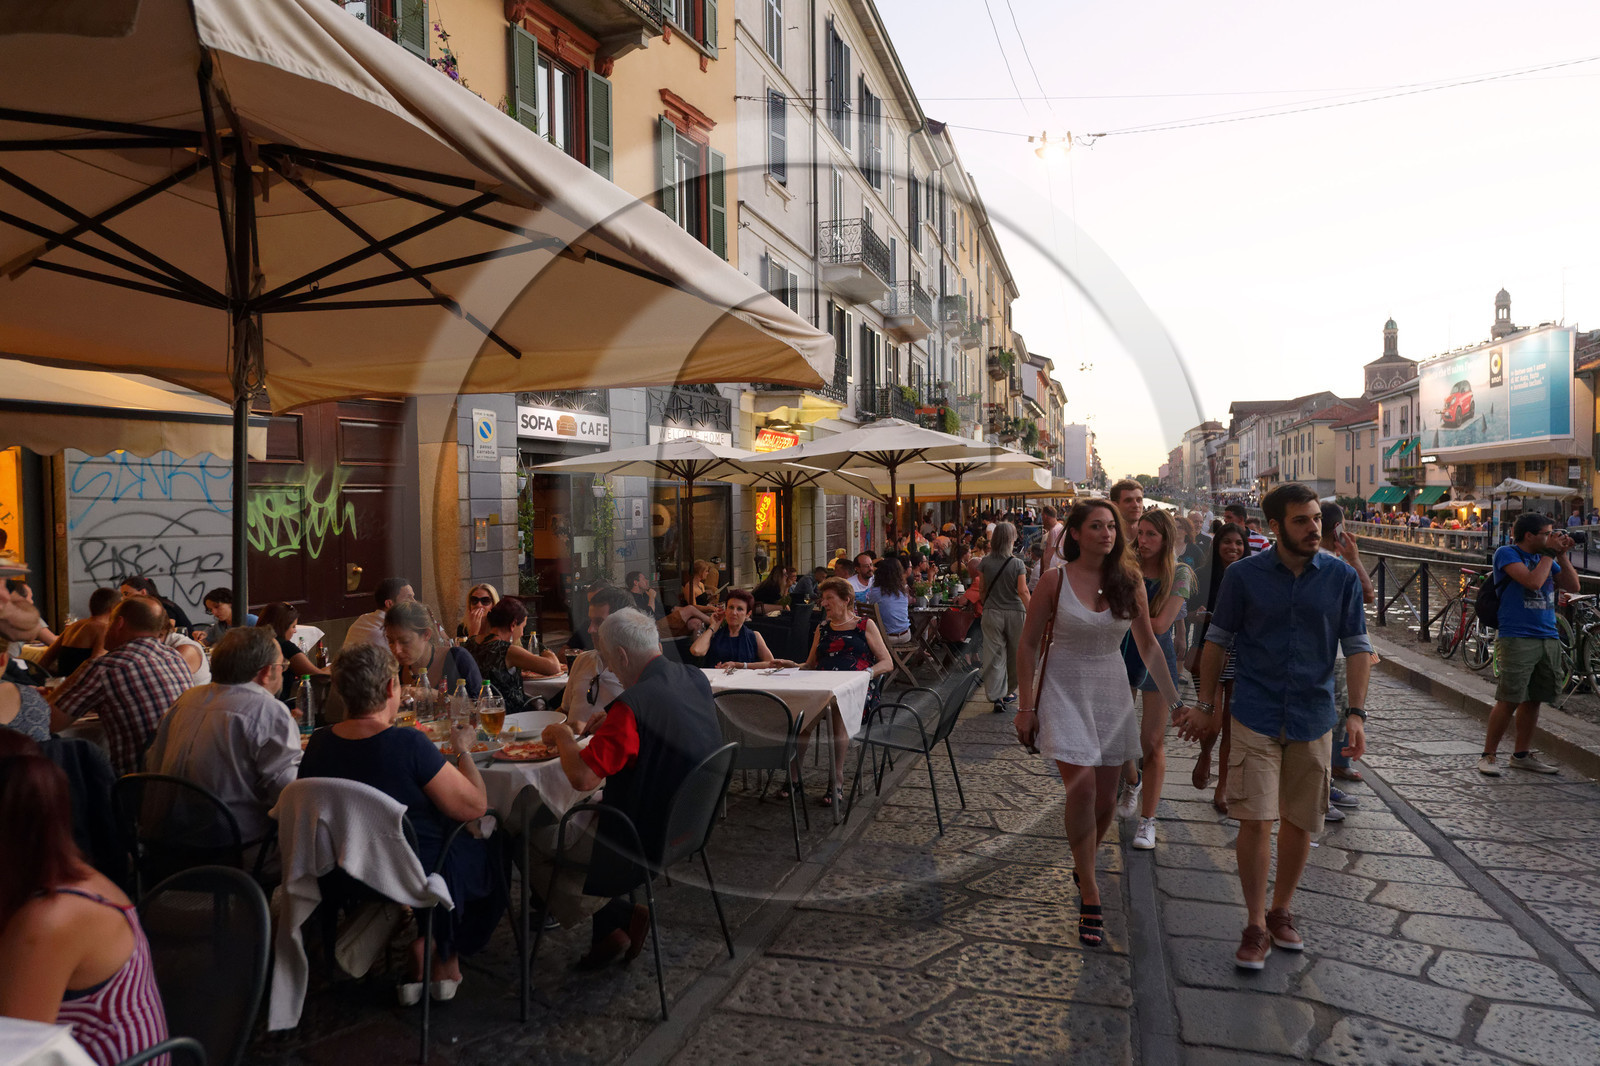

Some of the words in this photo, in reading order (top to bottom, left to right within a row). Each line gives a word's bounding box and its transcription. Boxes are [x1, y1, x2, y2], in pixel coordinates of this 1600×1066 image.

[520, 413, 554, 432] SOFA
[580, 421, 608, 437] CAFE
[703, 431, 725, 444] HOME
